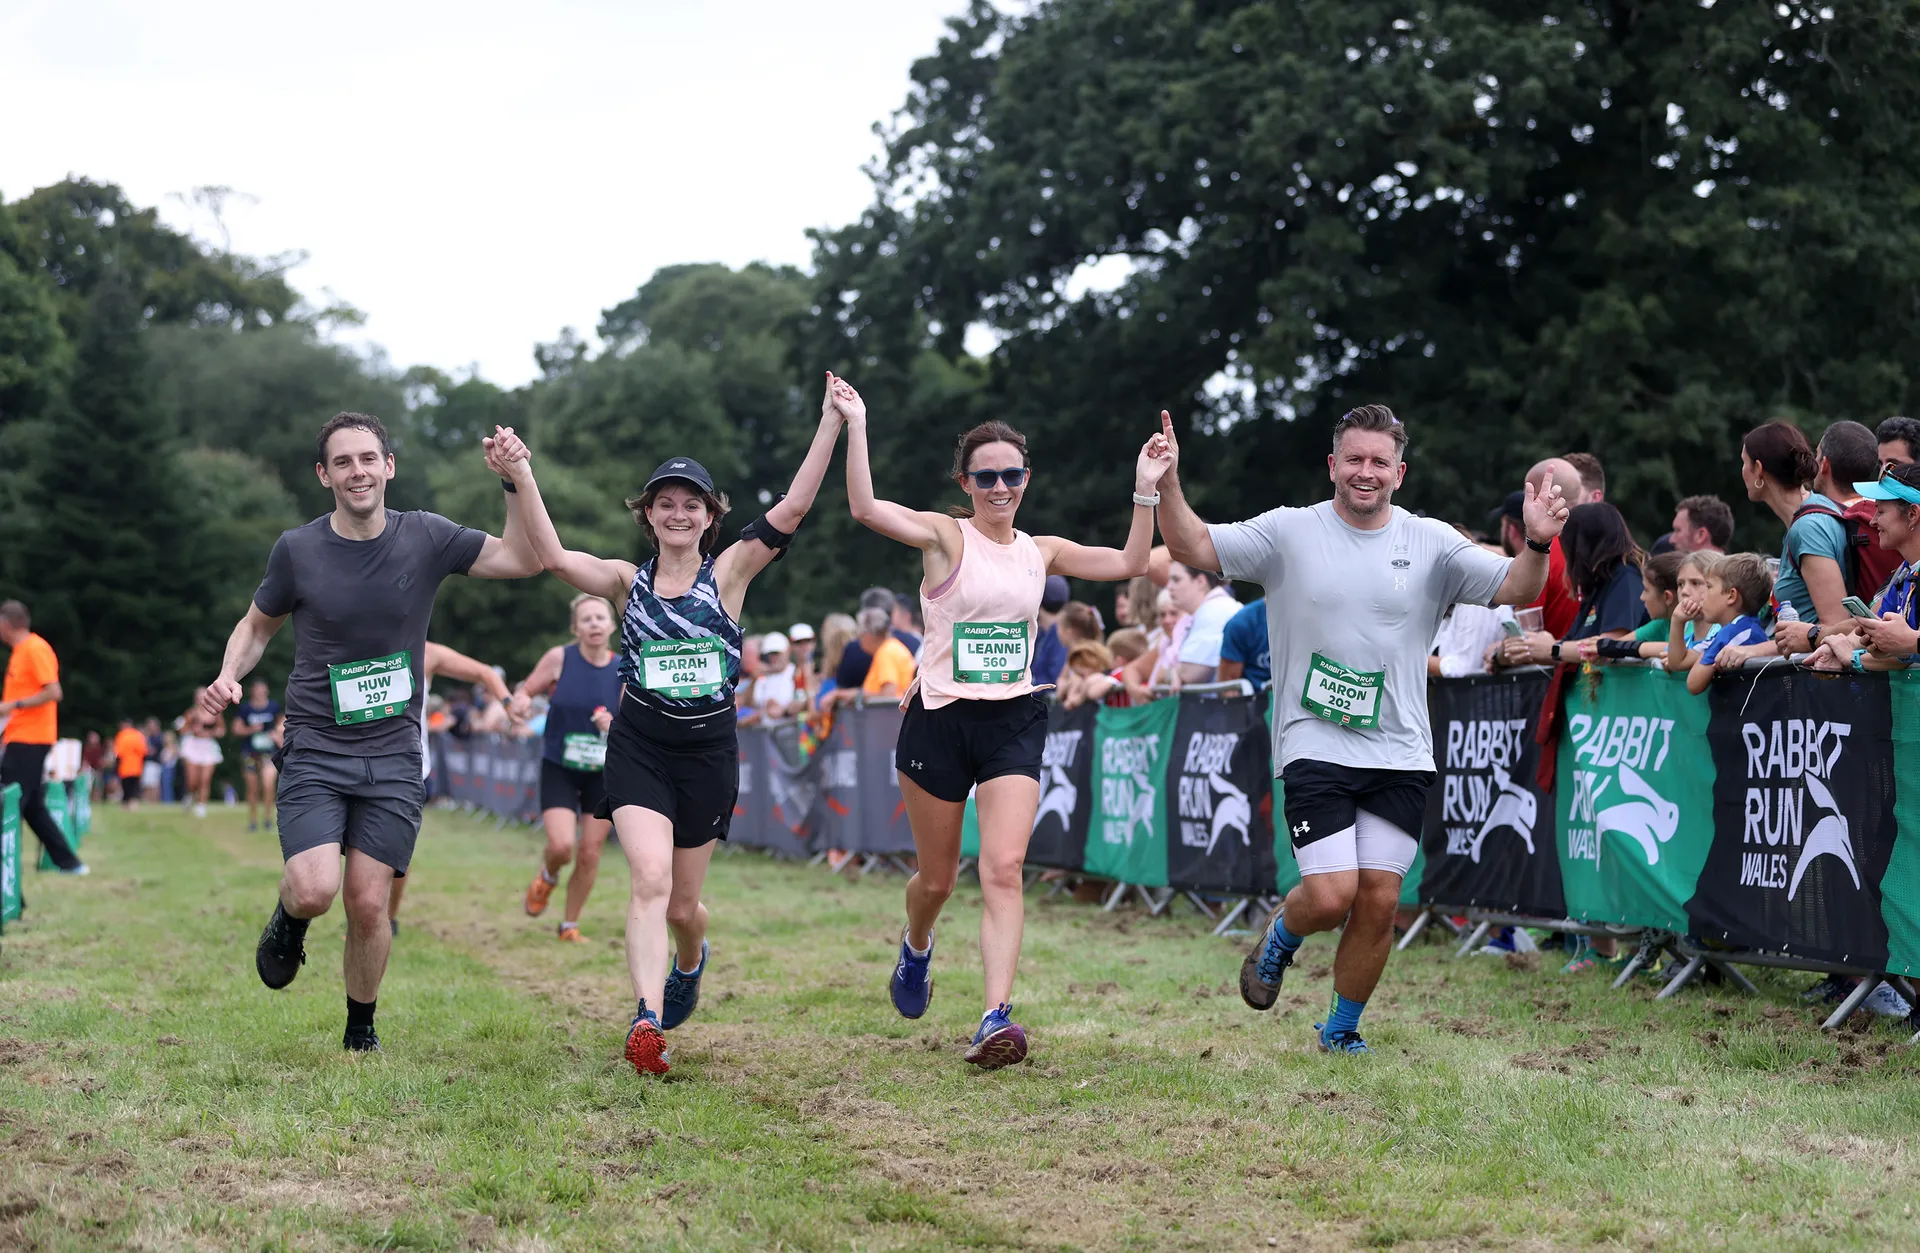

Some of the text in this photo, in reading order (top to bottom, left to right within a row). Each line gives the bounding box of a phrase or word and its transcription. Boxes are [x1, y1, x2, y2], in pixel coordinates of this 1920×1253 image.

[964, 627, 994, 635] RABBIT
[649, 641, 714, 653] RABBIT RUN
[967, 643, 1022, 654] LEANNE
[341, 656, 402, 676] RABBIT RUN
[658, 657, 708, 671] SARAH
[983, 656, 1008, 667] 560
[1319, 660, 1345, 676] RABBIT
[357, 675, 392, 692] HUW
[672, 672, 697, 683] 642
[365, 690, 388, 705] 297
[1319, 677, 1367, 701] AARON
[1328, 695, 1352, 710] 202
[1183, 731, 1240, 774] RABBIT
[1446, 718, 1528, 769] RABBIT
[1741, 718, 1852, 780] RABBIT
[1102, 778, 1135, 817] RUN
[1178, 775, 1213, 820] RUN
[1442, 774, 1493, 823] RUN
[1743, 787, 1804, 846] RUN
[1739, 852, 1788, 889] WALES
